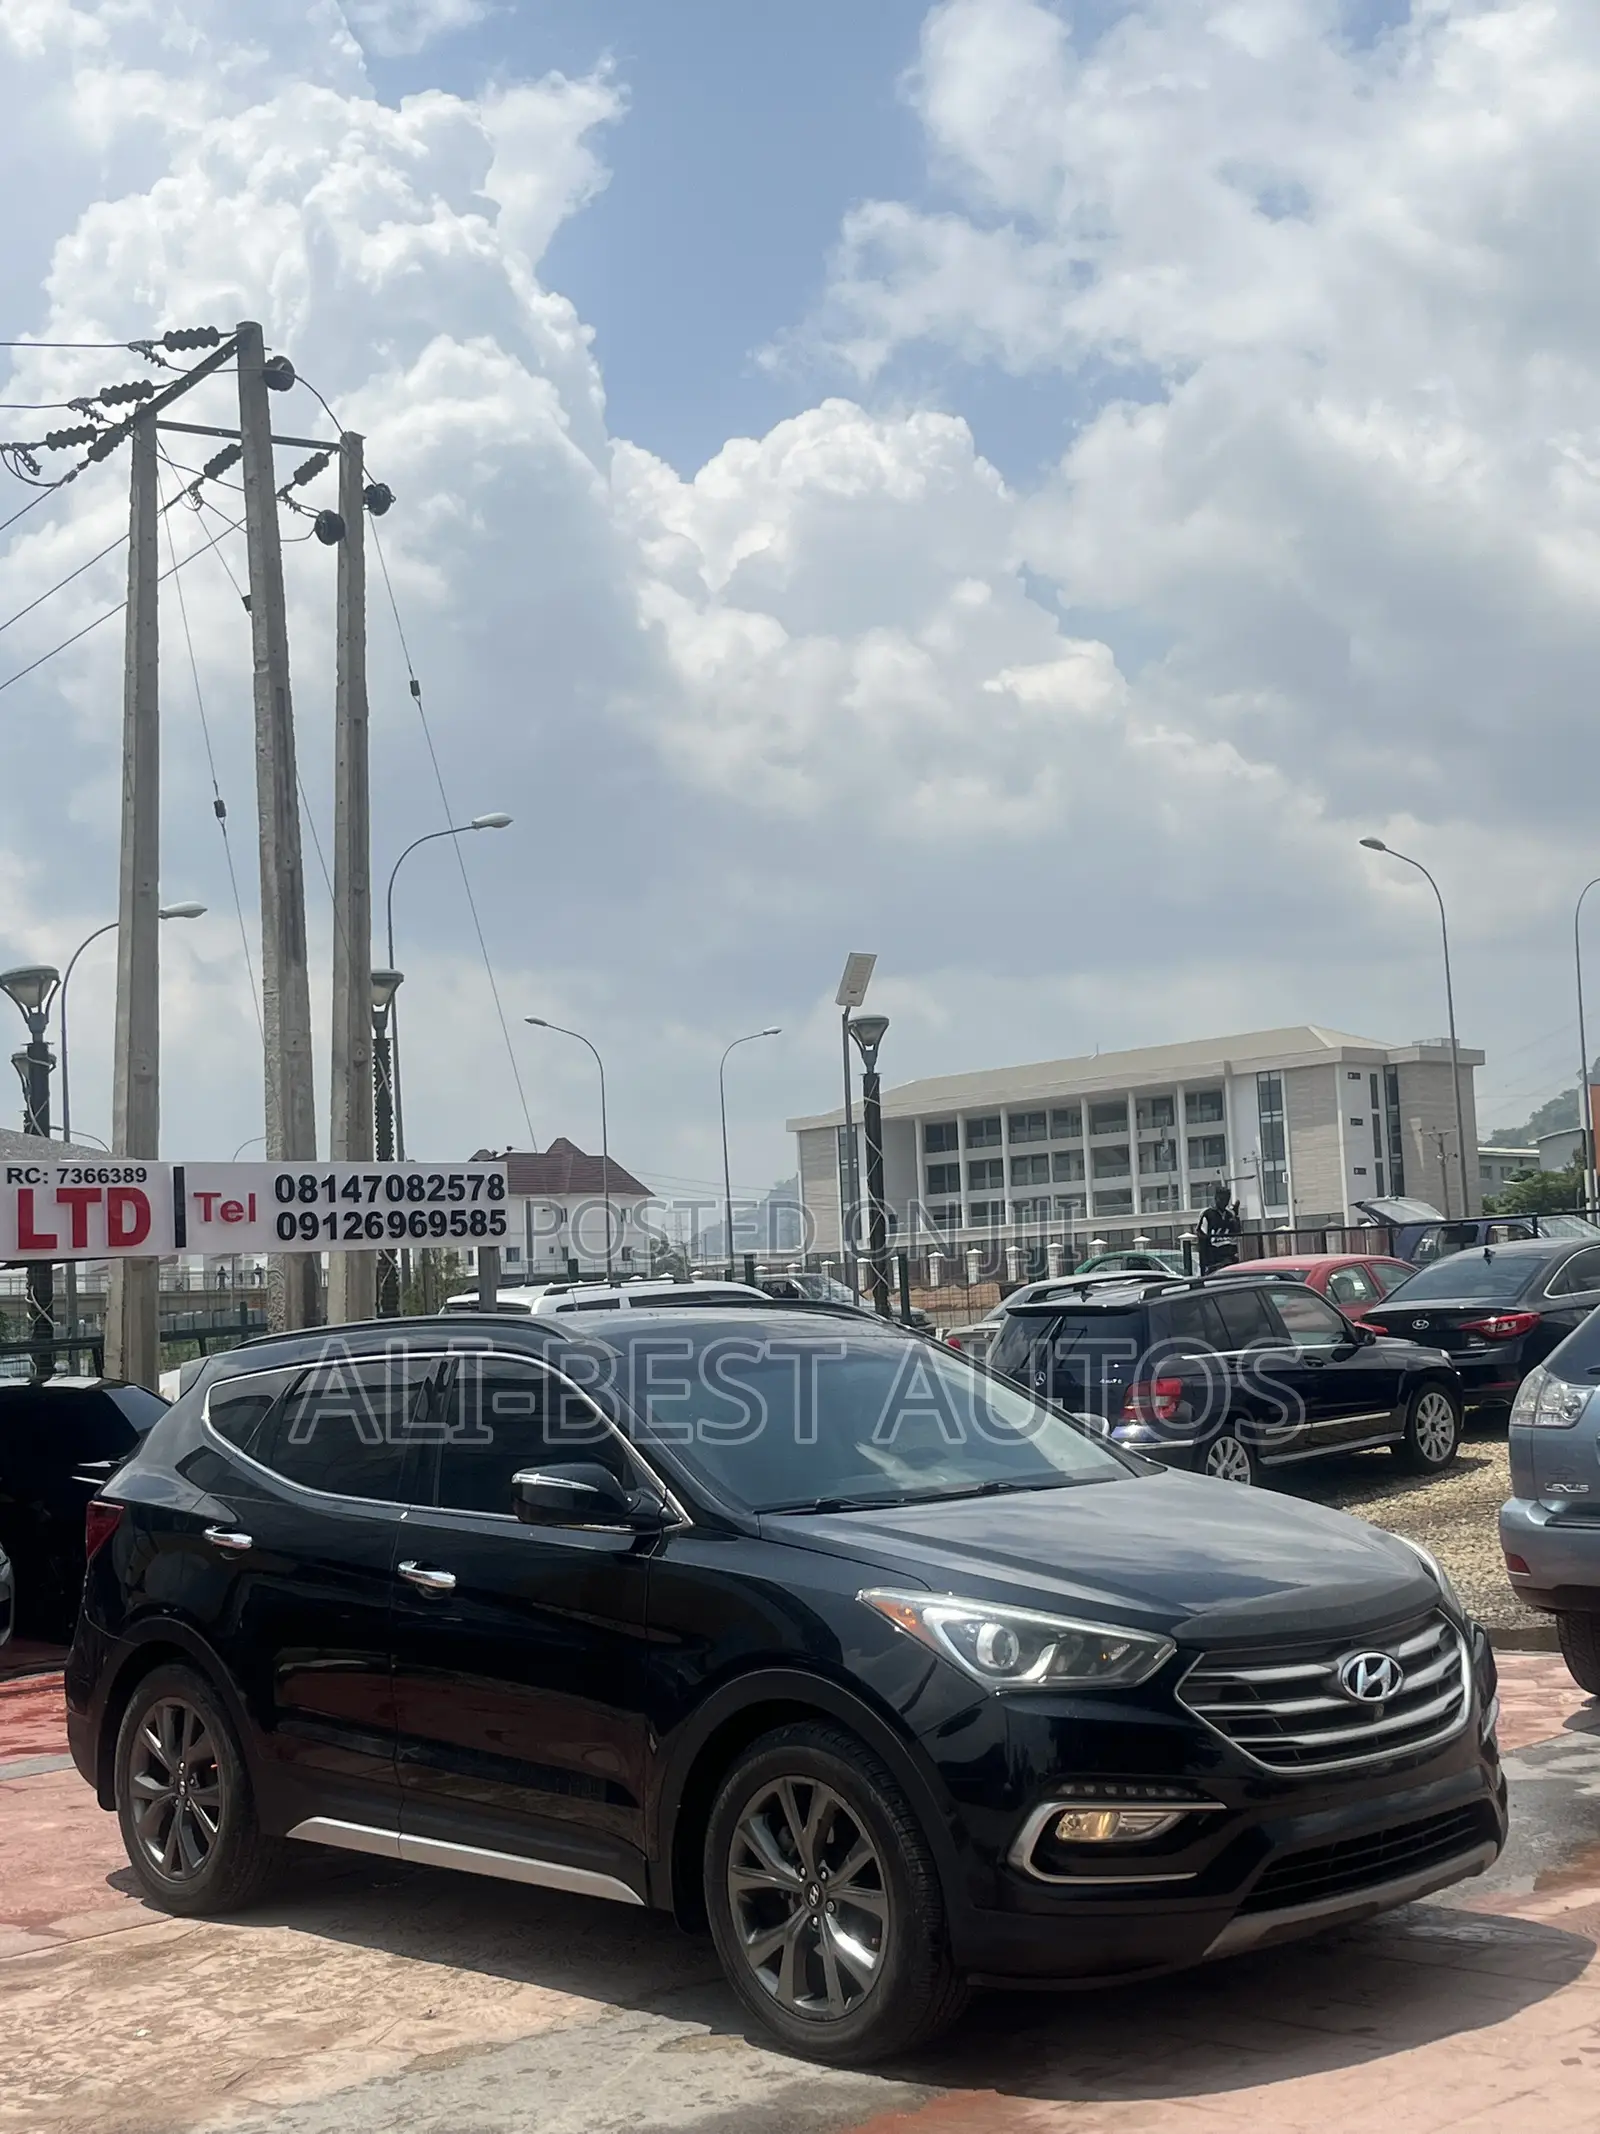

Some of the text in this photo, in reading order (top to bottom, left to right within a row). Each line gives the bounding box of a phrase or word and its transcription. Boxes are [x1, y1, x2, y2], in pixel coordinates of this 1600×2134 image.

[6, 1167, 148, 1184] RC: 7366389
[275, 1174, 505, 1203] 08147082578
[17, 1187, 152, 1250] LTD
[193, 1192, 256, 1223] Tel
[276, 1209, 507, 1241] 09126969585
